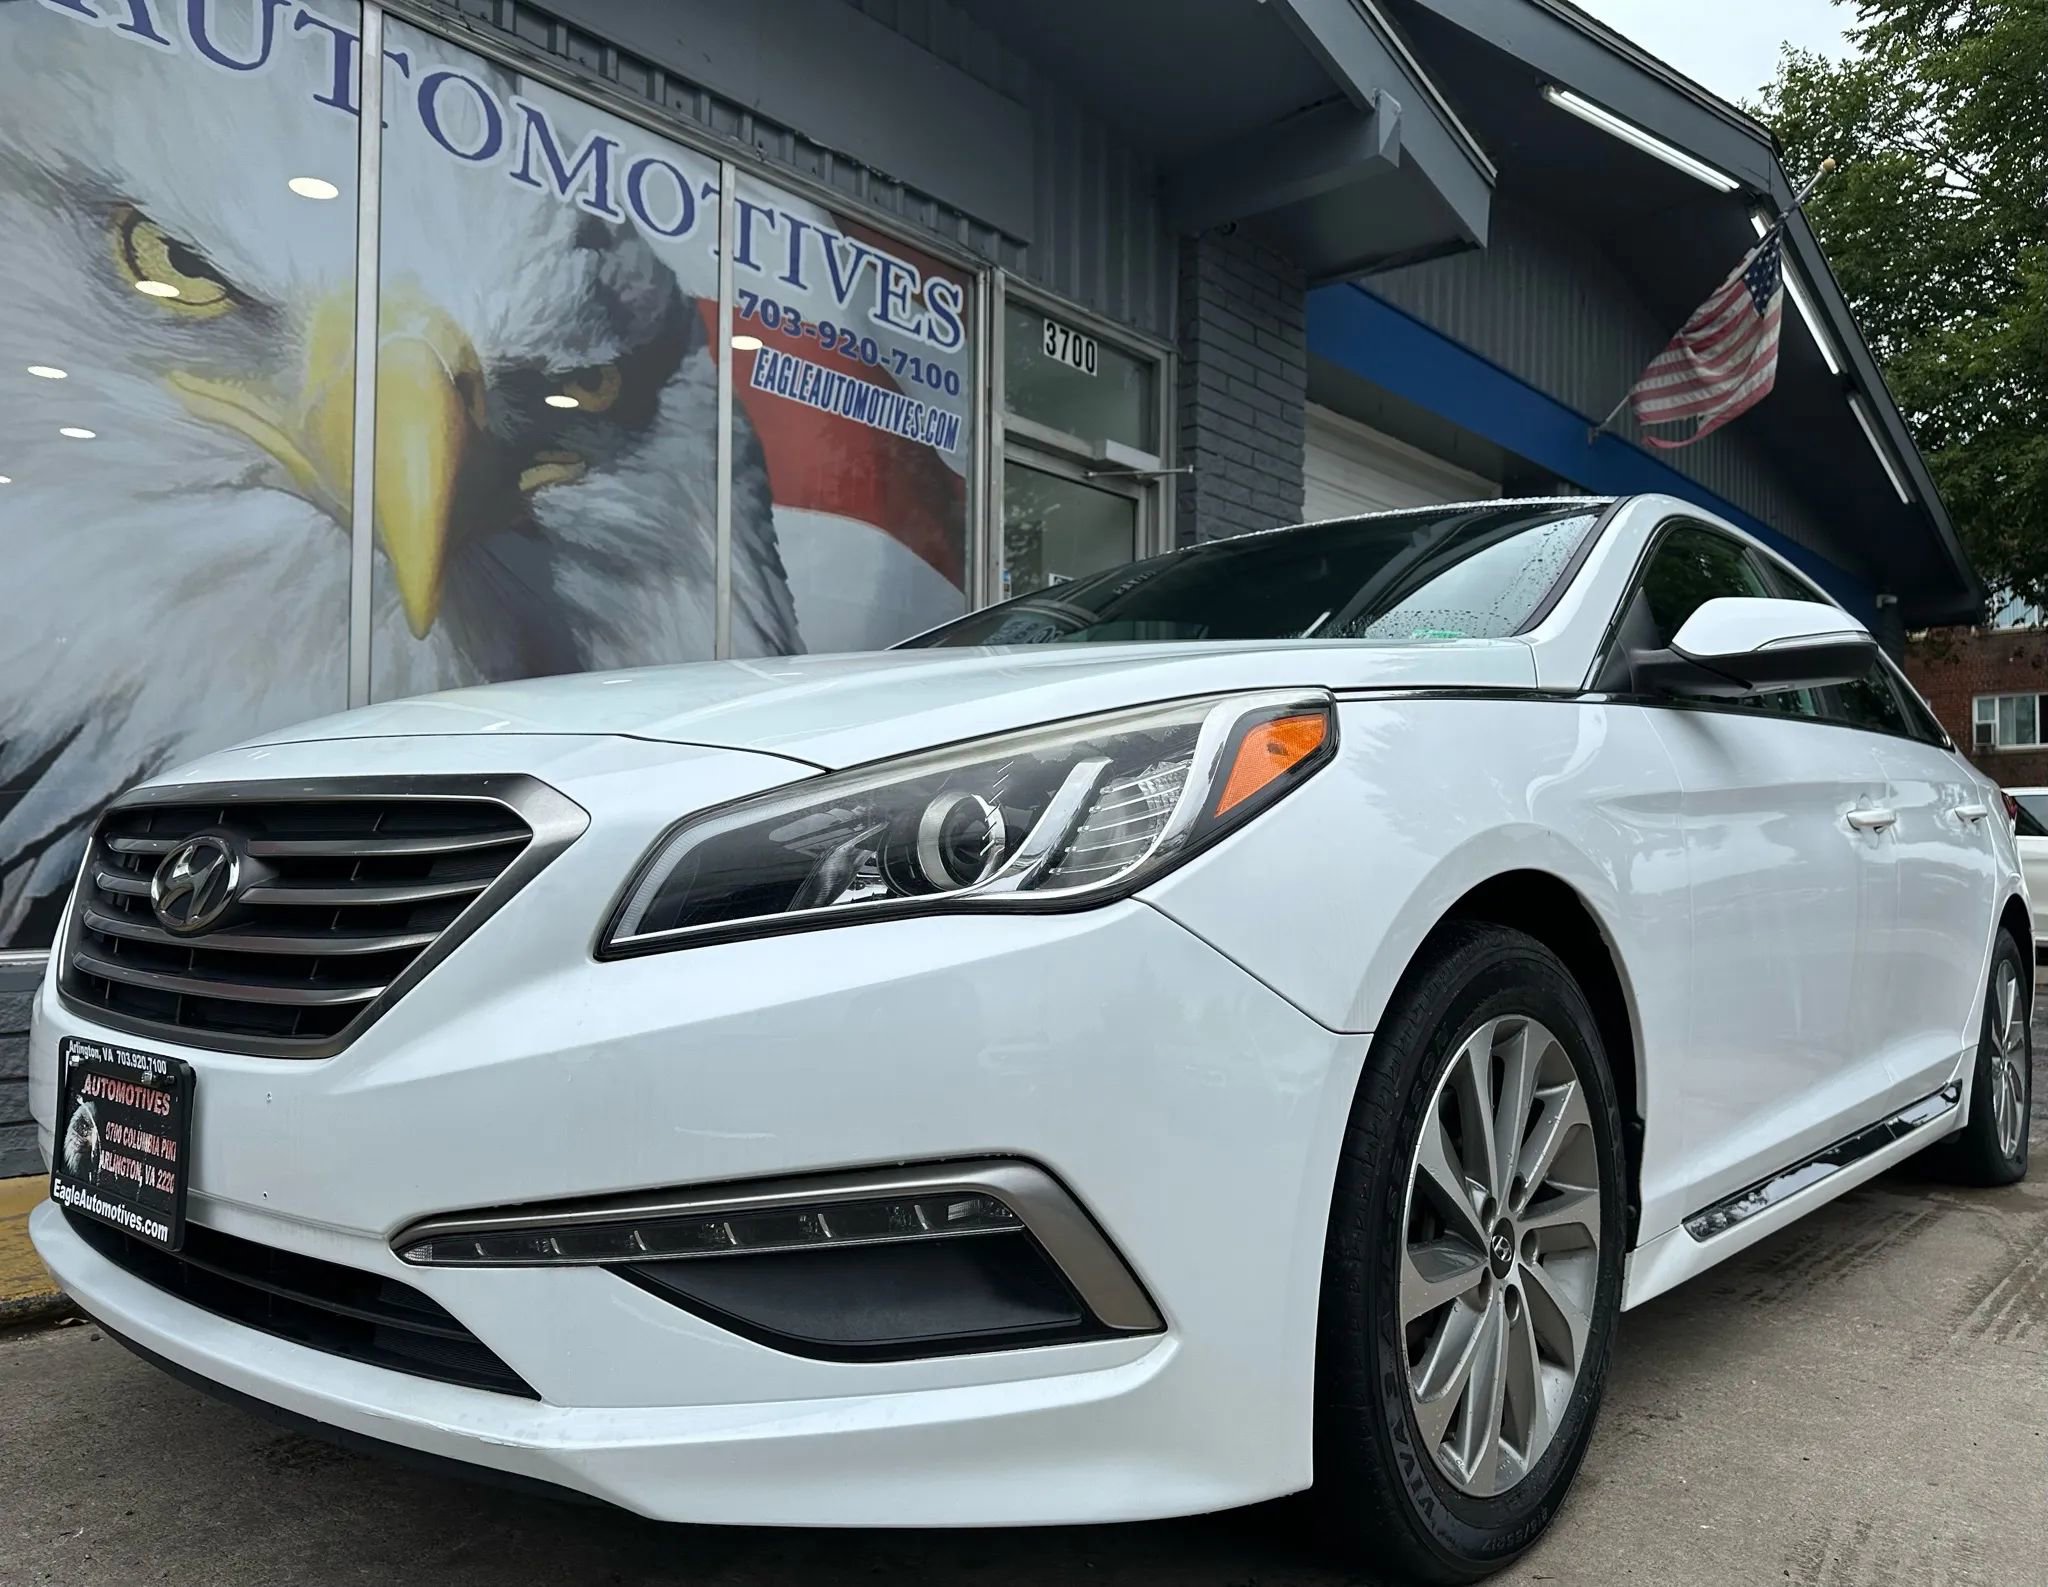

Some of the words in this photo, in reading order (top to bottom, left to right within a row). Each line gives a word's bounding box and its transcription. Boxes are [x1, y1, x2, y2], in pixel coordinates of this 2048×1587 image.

[738, 288, 960, 396] 703-920-7100
[1045, 324, 1096, 374] 3700
[753, 348, 960, 452] EAGLEAUTOMOTIVES.COM
[102, 1047, 114, 1062] VA
[116, 1050, 167, 1075] 703.920.7100
[81, 1073, 171, 1116] AUTOMOTIVES
[123, 1126, 160, 1157] COLUMBIA
[145, 1164, 156, 1187] VA
[53, 1178, 169, 1243] EagleAutomotives.com
